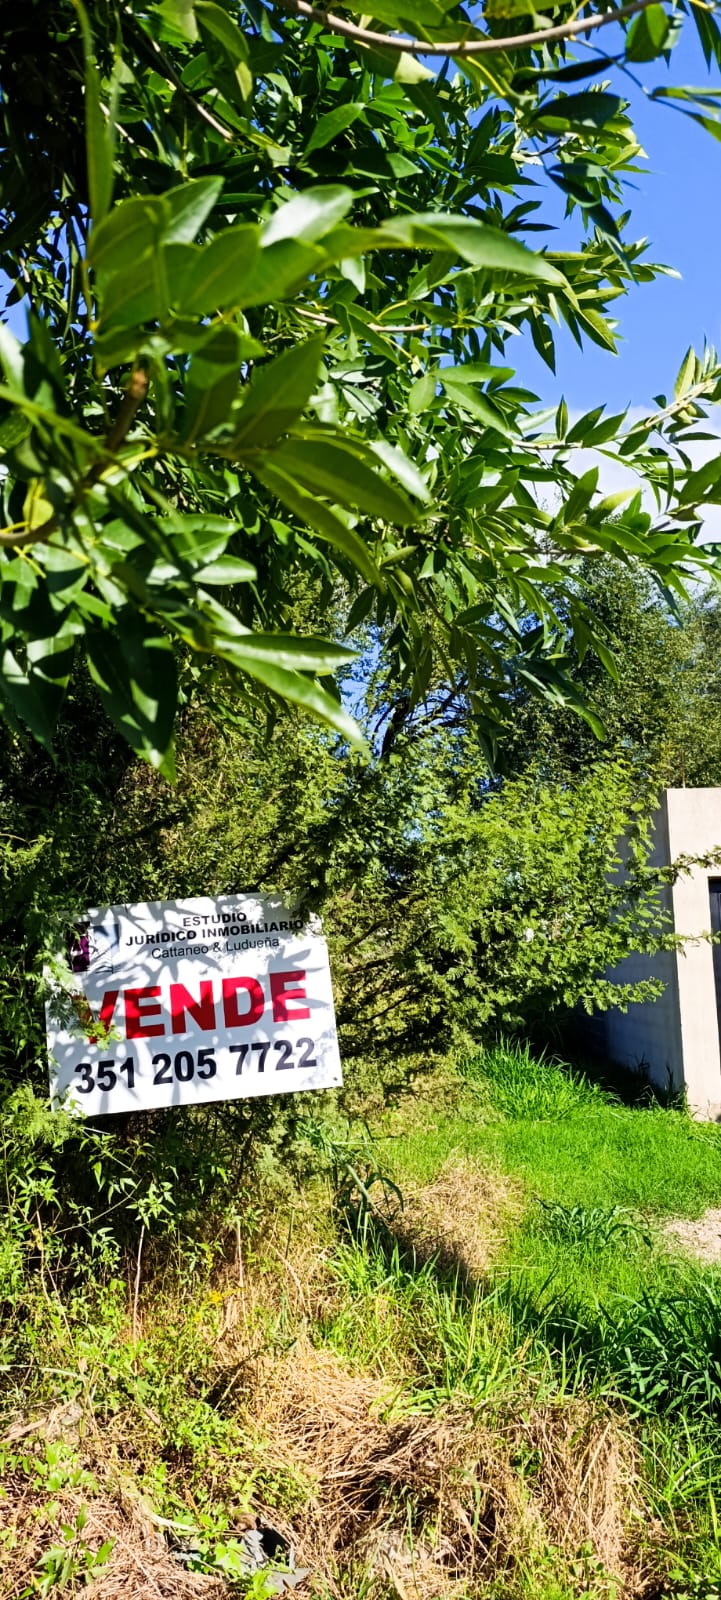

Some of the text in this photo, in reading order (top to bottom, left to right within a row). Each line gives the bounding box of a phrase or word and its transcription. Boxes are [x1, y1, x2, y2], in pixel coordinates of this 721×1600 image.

[182, 912, 247, 927] ESTUDIO
[202, 919, 304, 939] INMOBILIARIO
[151, 936, 280, 960] Cattaneo & Ludueña
[72, 970, 311, 1044] VENDE
[74, 1037, 317, 1094] 351 205 7722
